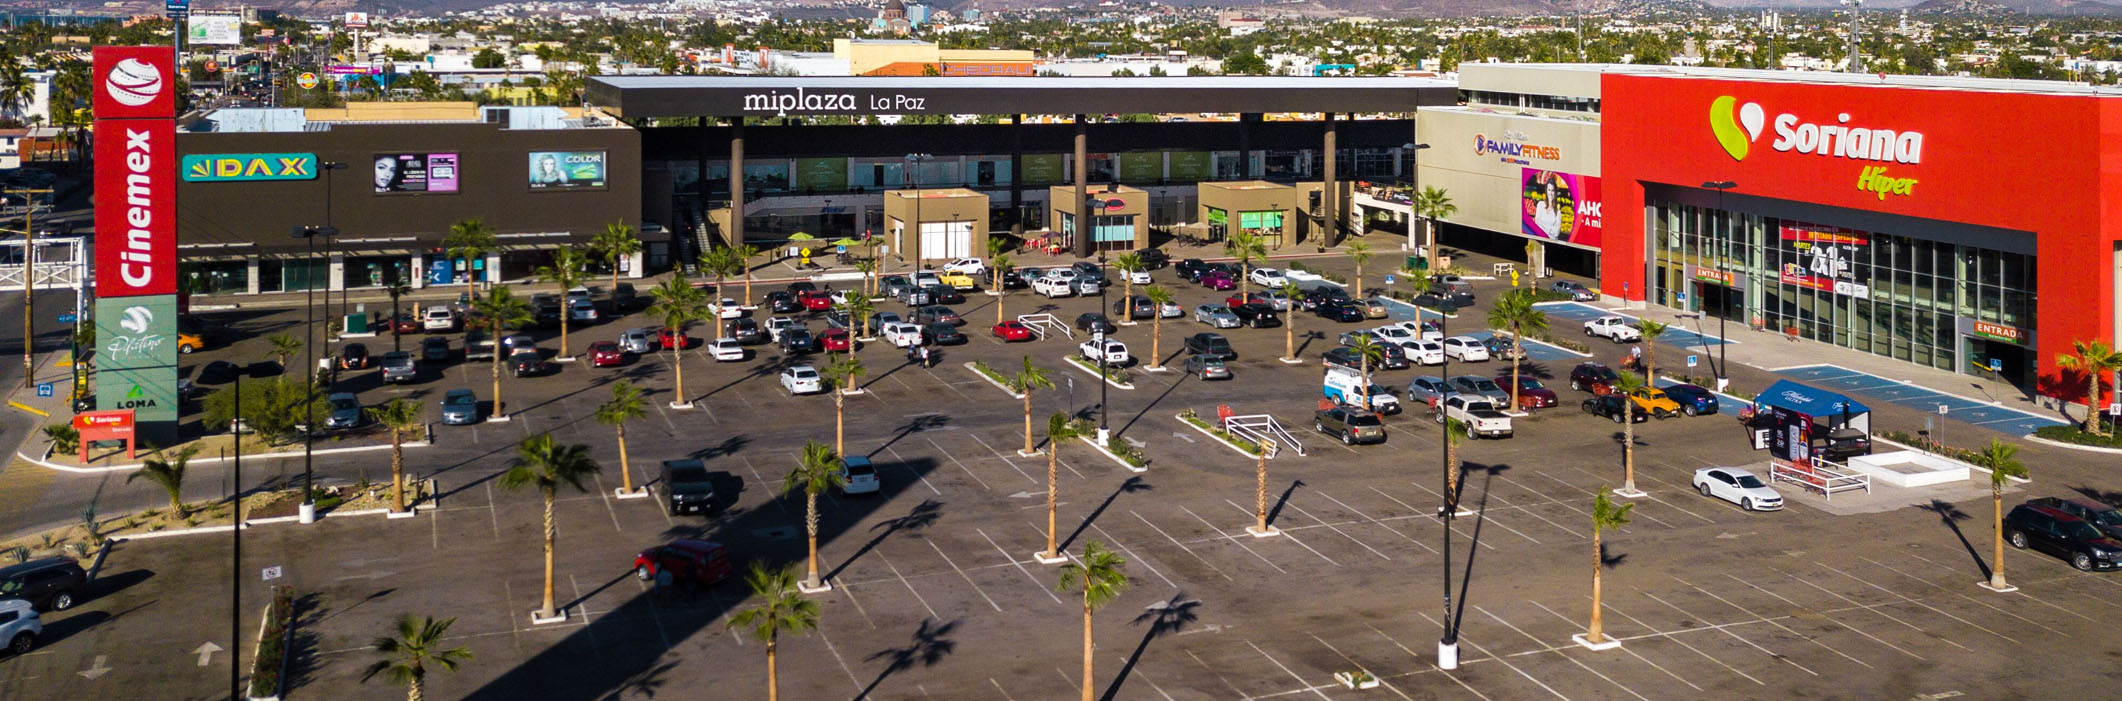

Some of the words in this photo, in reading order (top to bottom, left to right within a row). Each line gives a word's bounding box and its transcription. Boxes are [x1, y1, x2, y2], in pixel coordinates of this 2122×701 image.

[743, 87, 856, 117] miplaza
[870, 94, 890, 110] La
[896, 94, 925, 110] Paz
[1772, 112, 1923, 165] Soriana
[213, 157, 309, 177] DAX
[565, 155, 601, 163] COLOR
[120, 128, 152, 288] Cinemex
[1697, 269, 1729, 281] ENTRAA
[1977, 323, 2024, 340] ENTRADA
[117, 399, 156, 409] LOMA
